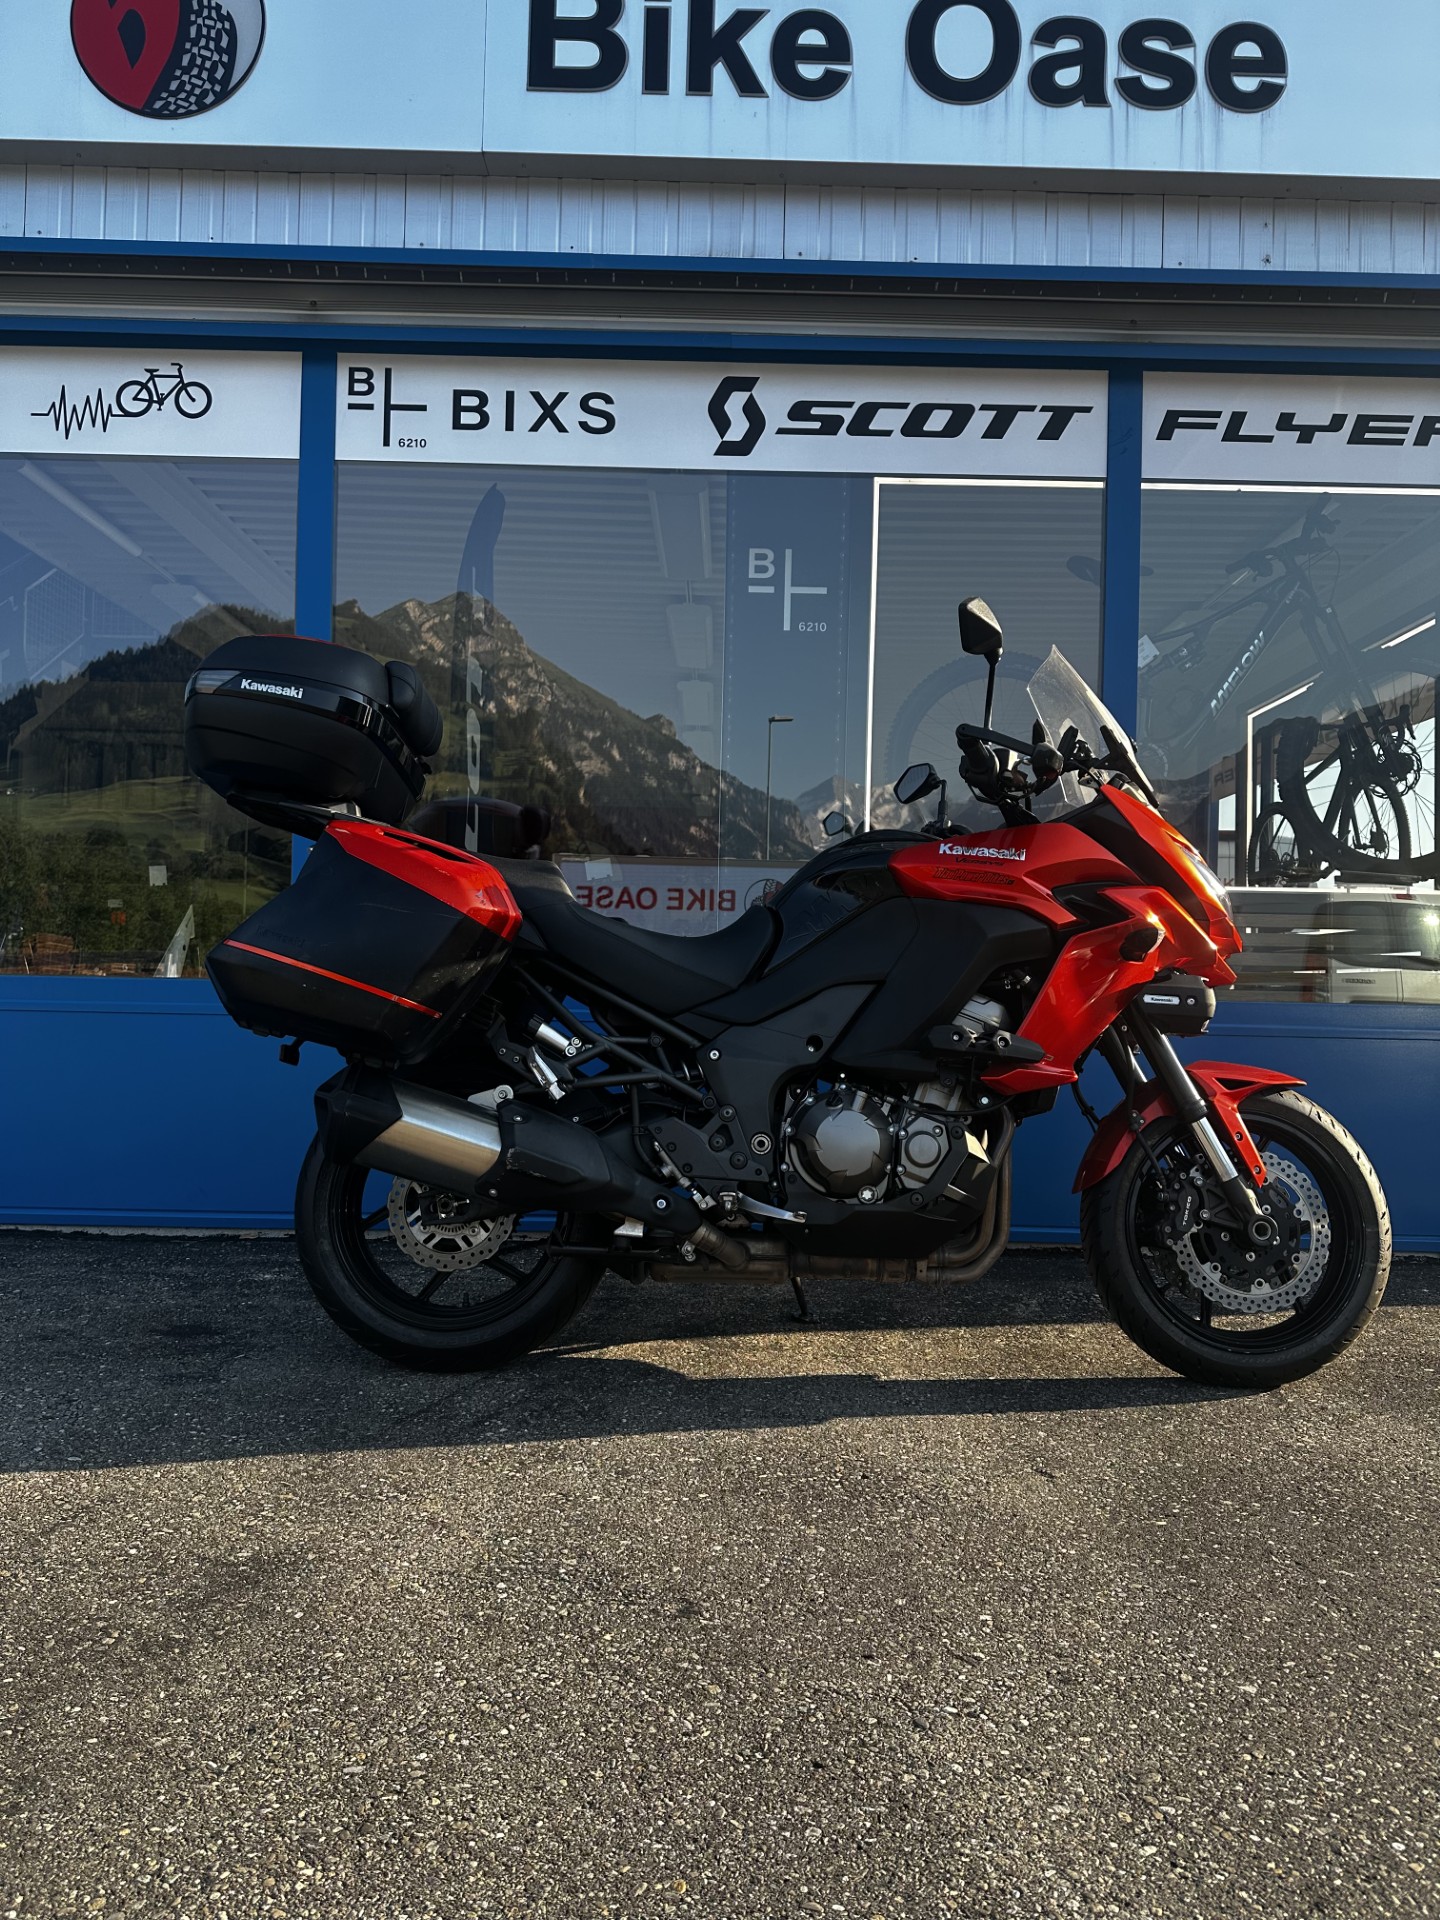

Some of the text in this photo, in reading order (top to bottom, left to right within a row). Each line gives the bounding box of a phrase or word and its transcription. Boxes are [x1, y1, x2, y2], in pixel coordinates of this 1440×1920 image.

[526, 0, 1288, 114] Bike Oase
[452, 389, 615, 434] BIXS
[775, 401, 1093, 440] SCOTT
[398, 437, 427, 449] 6210
[798, 622, 827, 632] 6210
[240, 679, 303, 699] Kawasaki
[938, 843, 1026, 861] Kawasaki
[1182, 1195, 1192, 1226] TOKICO
